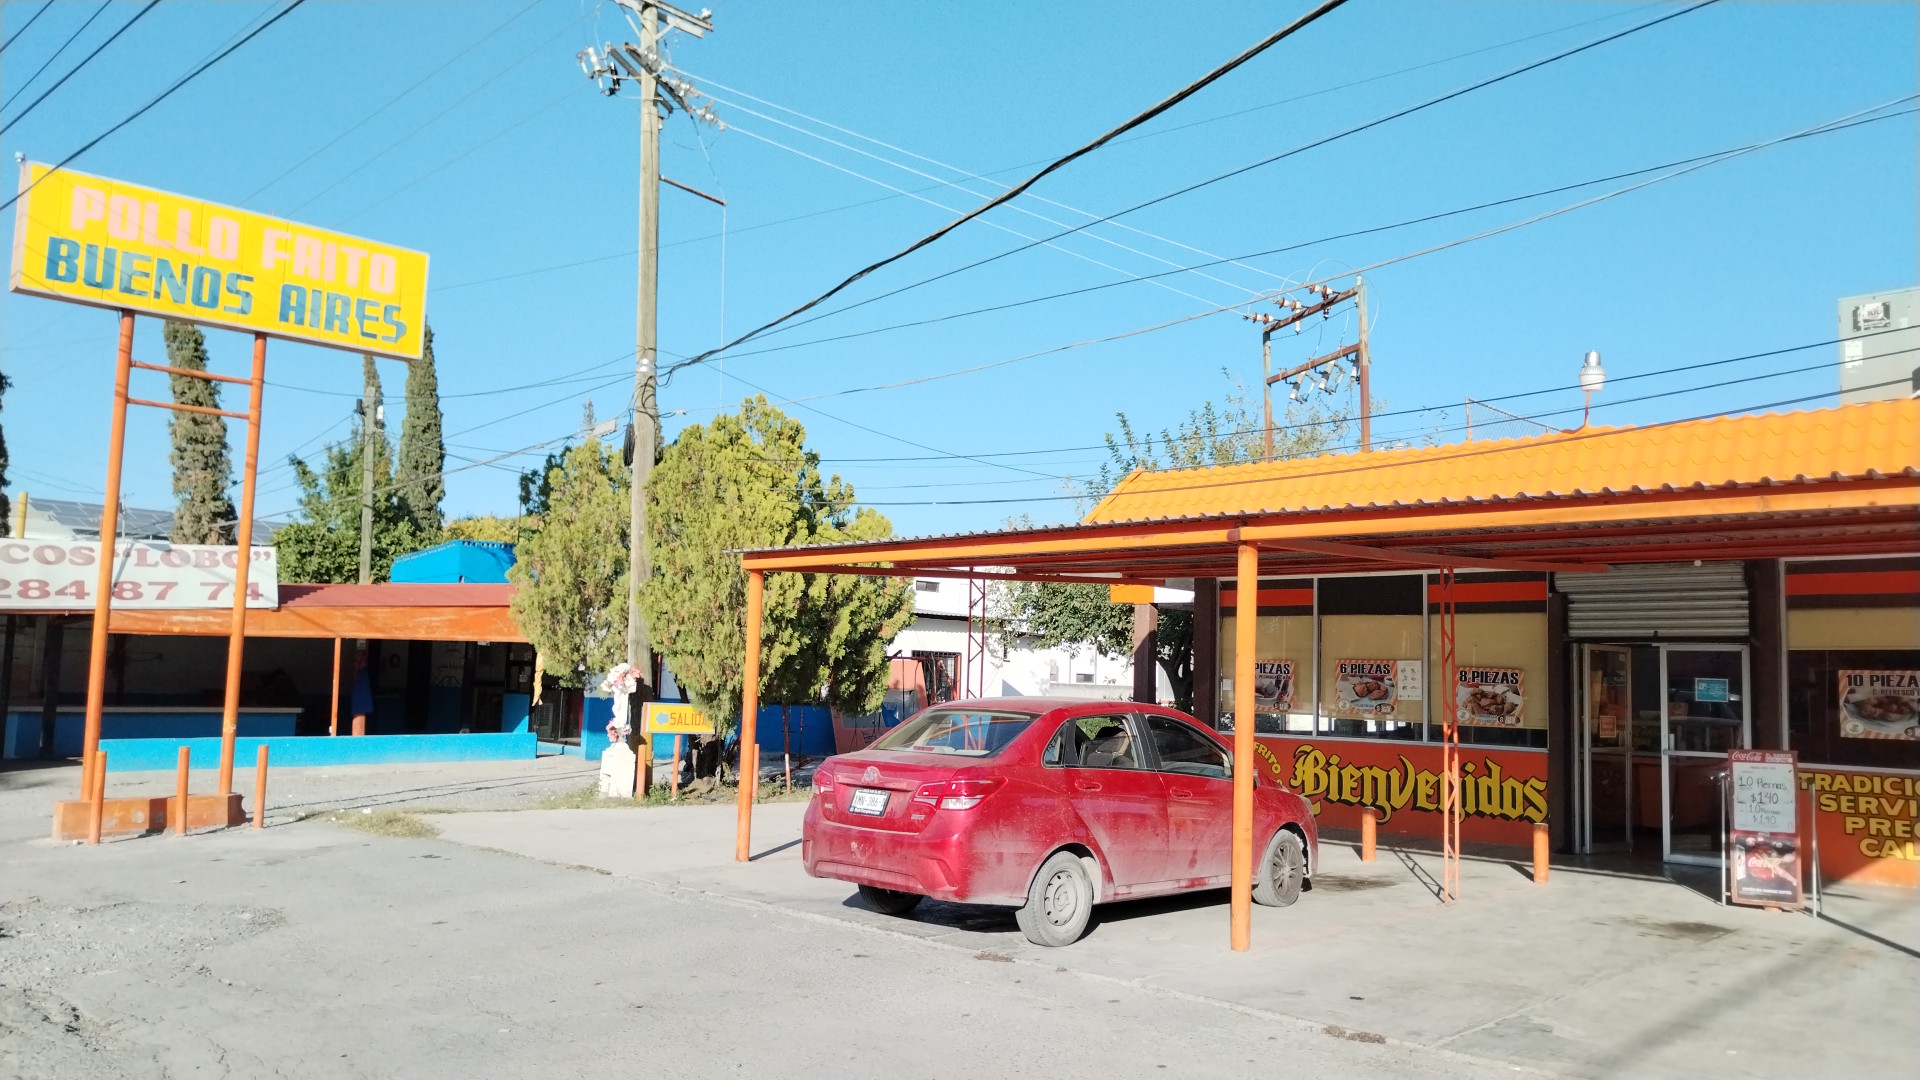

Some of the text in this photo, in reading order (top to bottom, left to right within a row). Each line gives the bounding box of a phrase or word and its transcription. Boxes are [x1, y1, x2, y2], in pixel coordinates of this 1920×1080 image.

[69, 186, 397, 294] POLLO FRITO
[45, 236, 407, 344] BUENOS AIRES
[112, 581, 178, 600] 87
[1340, 663, 1391, 674] 6 PIEZAS
[1459, 670, 1518, 684] 8 PIEZAS
[1846, 675, 1863, 686] 10
[1739, 776, 1753, 787] 10
[1751, 792, 1779, 804] $140
